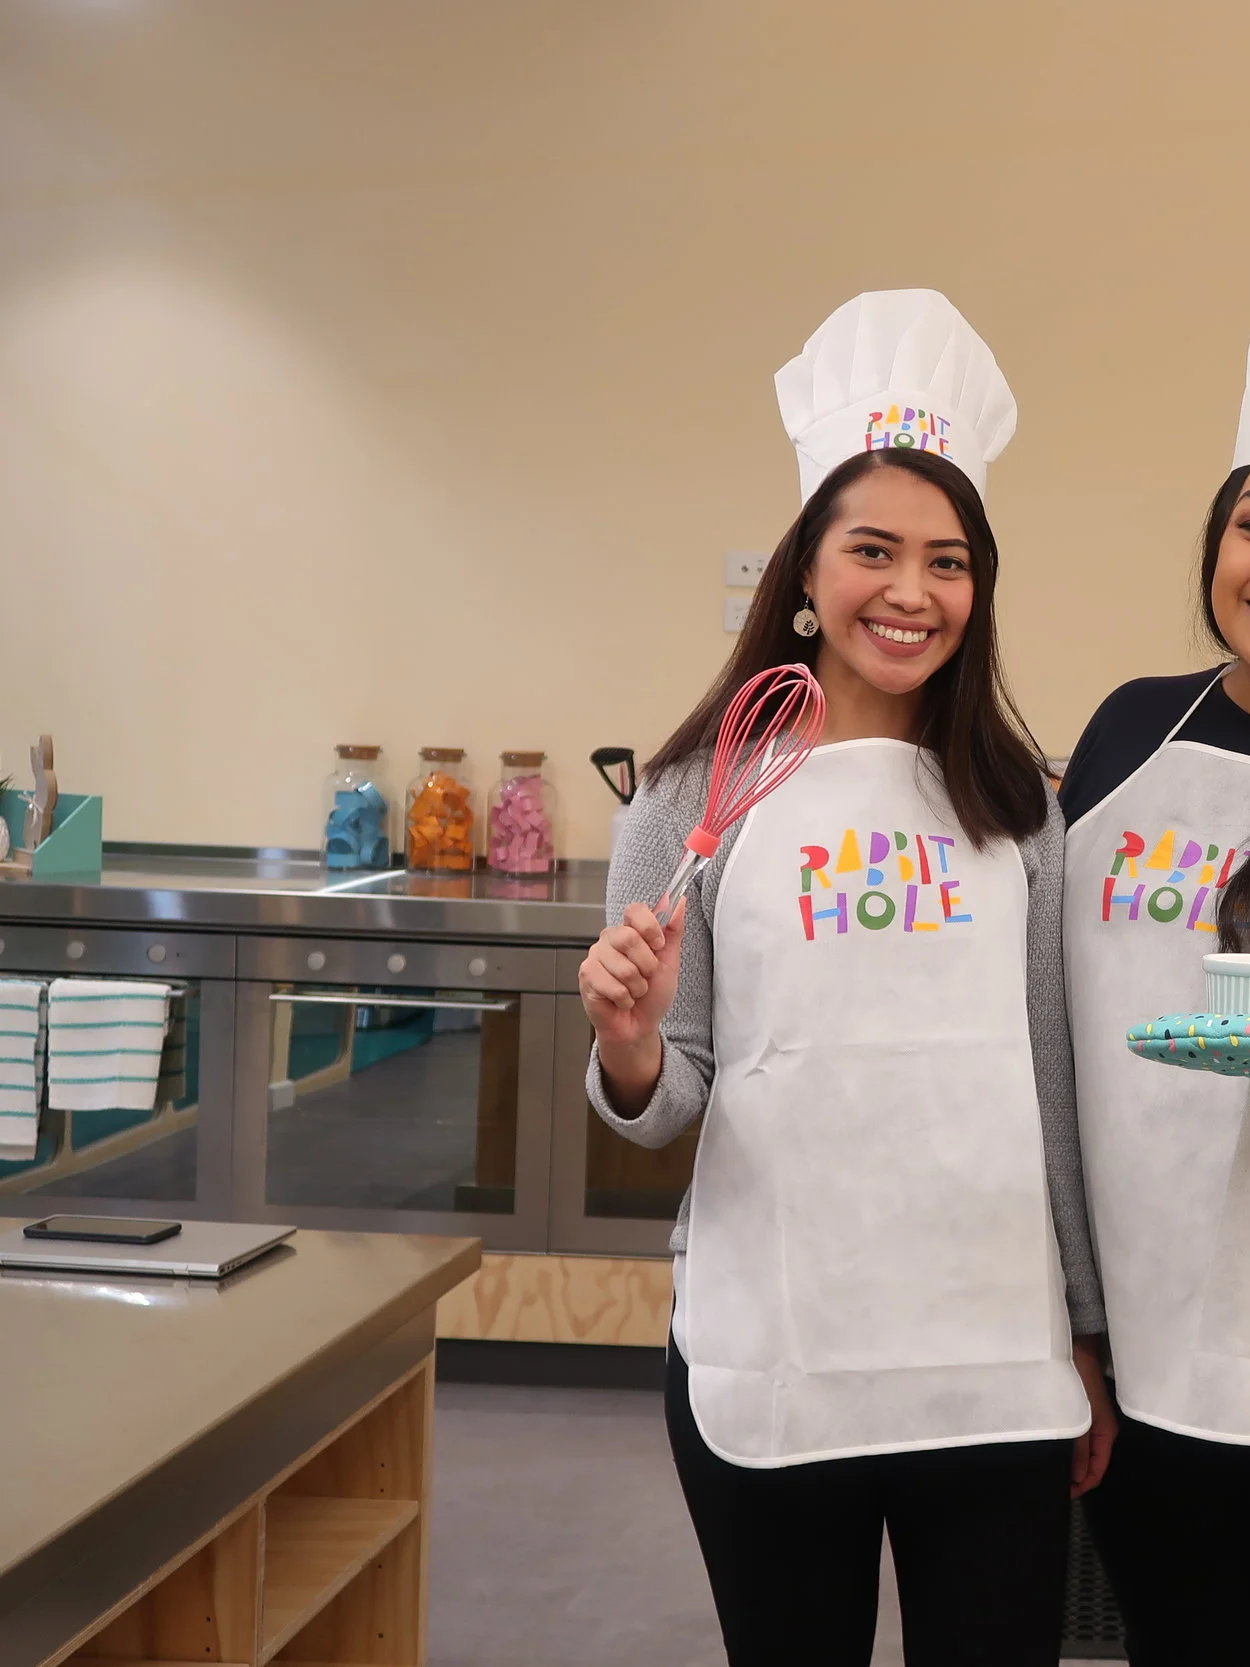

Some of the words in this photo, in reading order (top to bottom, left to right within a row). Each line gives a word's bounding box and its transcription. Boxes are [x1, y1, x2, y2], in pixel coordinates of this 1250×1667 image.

[865, 431, 953, 459] HOLE
[869, 404, 951, 435] RABBIT
[800, 828, 955, 893] RABBIT
[798, 880, 973, 941] HOLE
[1102, 877, 1224, 933] HOL
